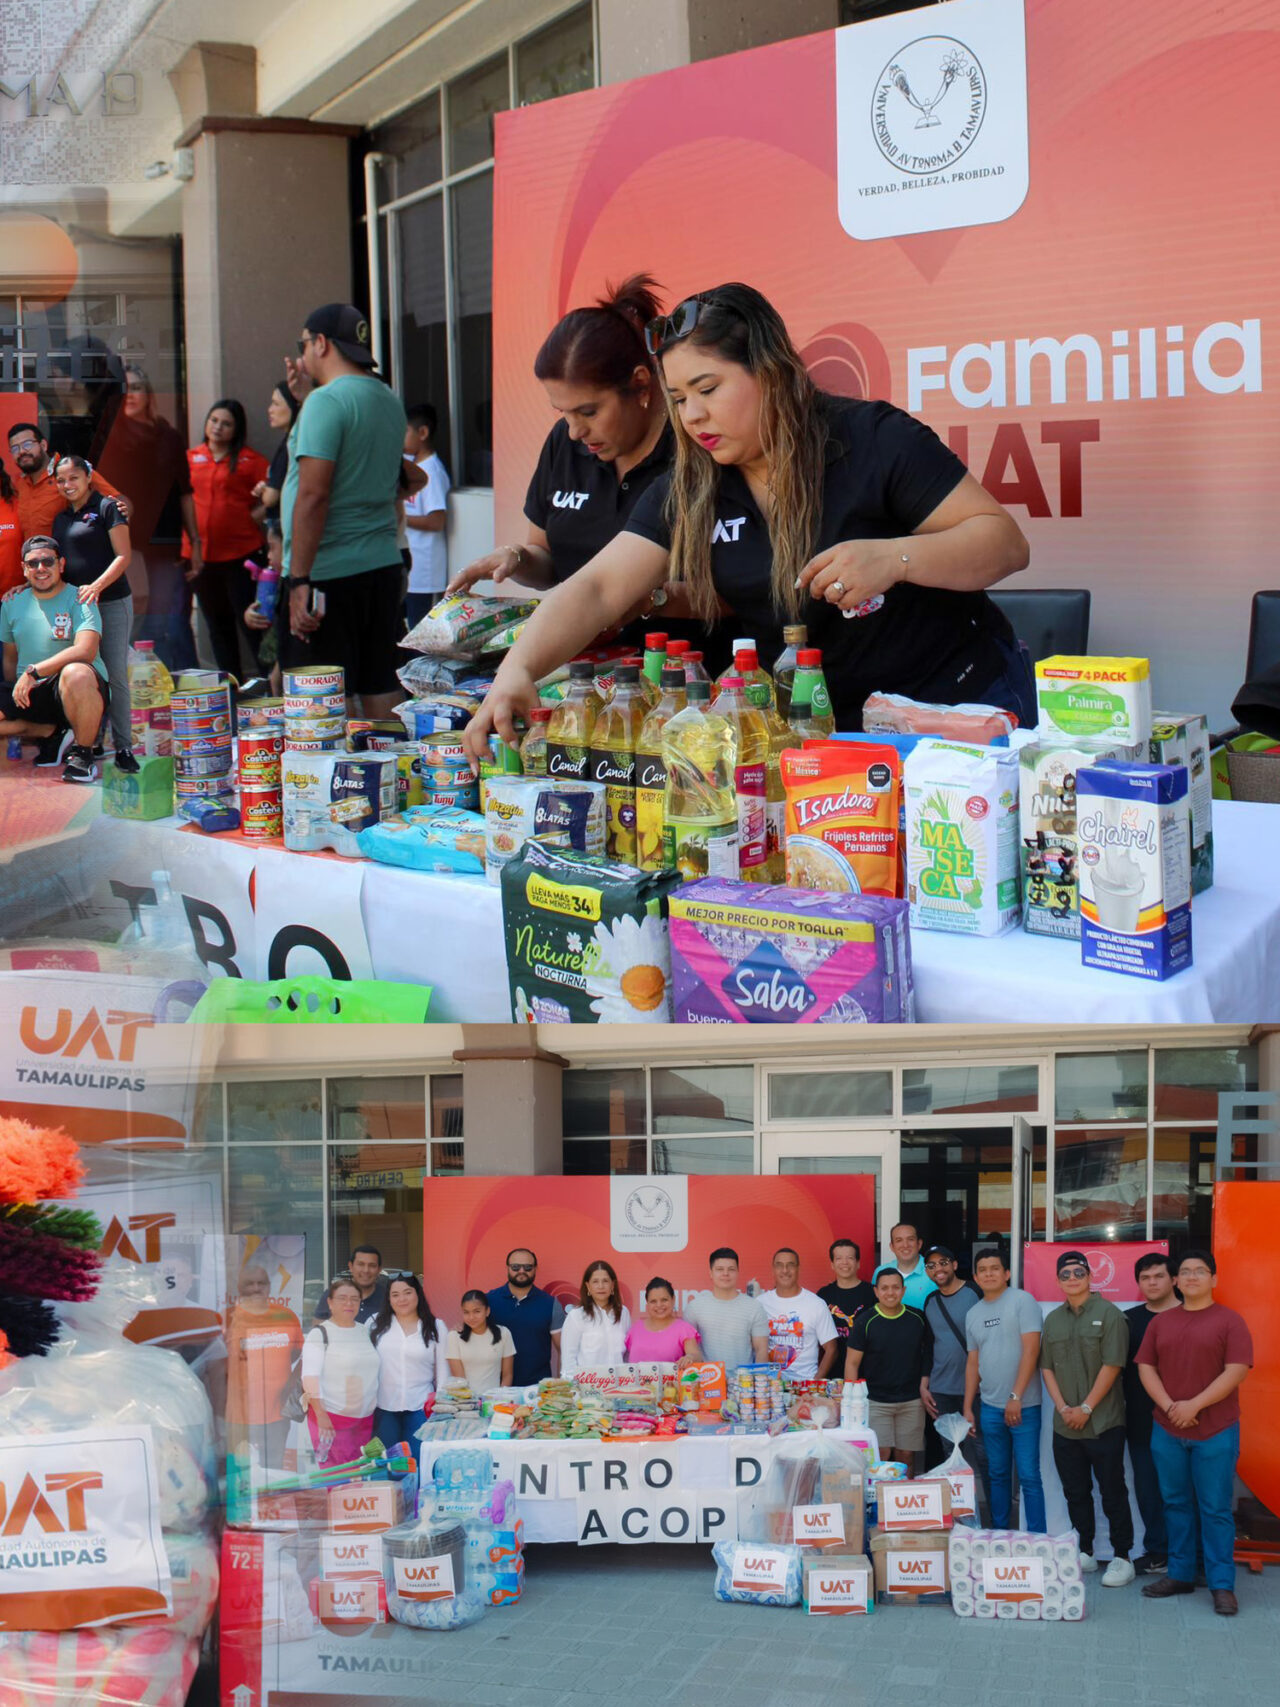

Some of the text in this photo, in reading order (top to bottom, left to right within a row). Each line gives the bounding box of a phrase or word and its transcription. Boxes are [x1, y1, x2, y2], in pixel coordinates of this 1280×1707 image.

[858, 166, 1005, 197] VERDAD, BELLEZA, PROBIDAD
[907, 318, 1262, 412] Familia
[552, 490, 590, 510] UAT
[711, 516, 747, 543] AT
[1093, 671, 1127, 682] PACK
[1068, 694, 1113, 711] Palmira
[550, 754, 584, 775] Canoil
[596, 758, 634, 782] Canoil
[797, 786, 873, 826] Isadora
[824, 831, 895, 843] Frijoles Refritos
[921, 821, 963, 850] MA
[1079, 812, 1157, 854] Chairel
[844, 841, 887, 852] Peruanos
[937, 849, 972, 876] SE
[531, 886, 570, 902] LLEVA MÁS
[920, 871, 959, 899] CA
[532, 894, 571, 910] PAGA MENOS
[572, 896, 591, 914] 34
[686, 907, 844, 937] MEJOR PRECIO POR TOALLA
[537, 966, 587, 989] NOCTURNA
[733, 968, 809, 1013] Saba
[19, 1005, 155, 1062] UAT
[135, 1066, 147, 1077] de
[16, 1069, 146, 1093] TAMAULIPAS
[99, 1212, 176, 1264] AT
[343, 1496, 378, 1511] UAT
[894, 1494, 929, 1508] UAT
[803, 1513, 831, 1527] UAT
[231, 1551, 251, 1569] 72
[334, 1545, 369, 1559] UAT
[404, 1565, 440, 1580] UAT
[743, 1557, 777, 1571] UAT
[898, 1560, 933, 1574] UAT
[994, 1566, 1030, 1581] UAT
[820, 1579, 855, 1594] UAT
[330, 1591, 365, 1605] UAT
